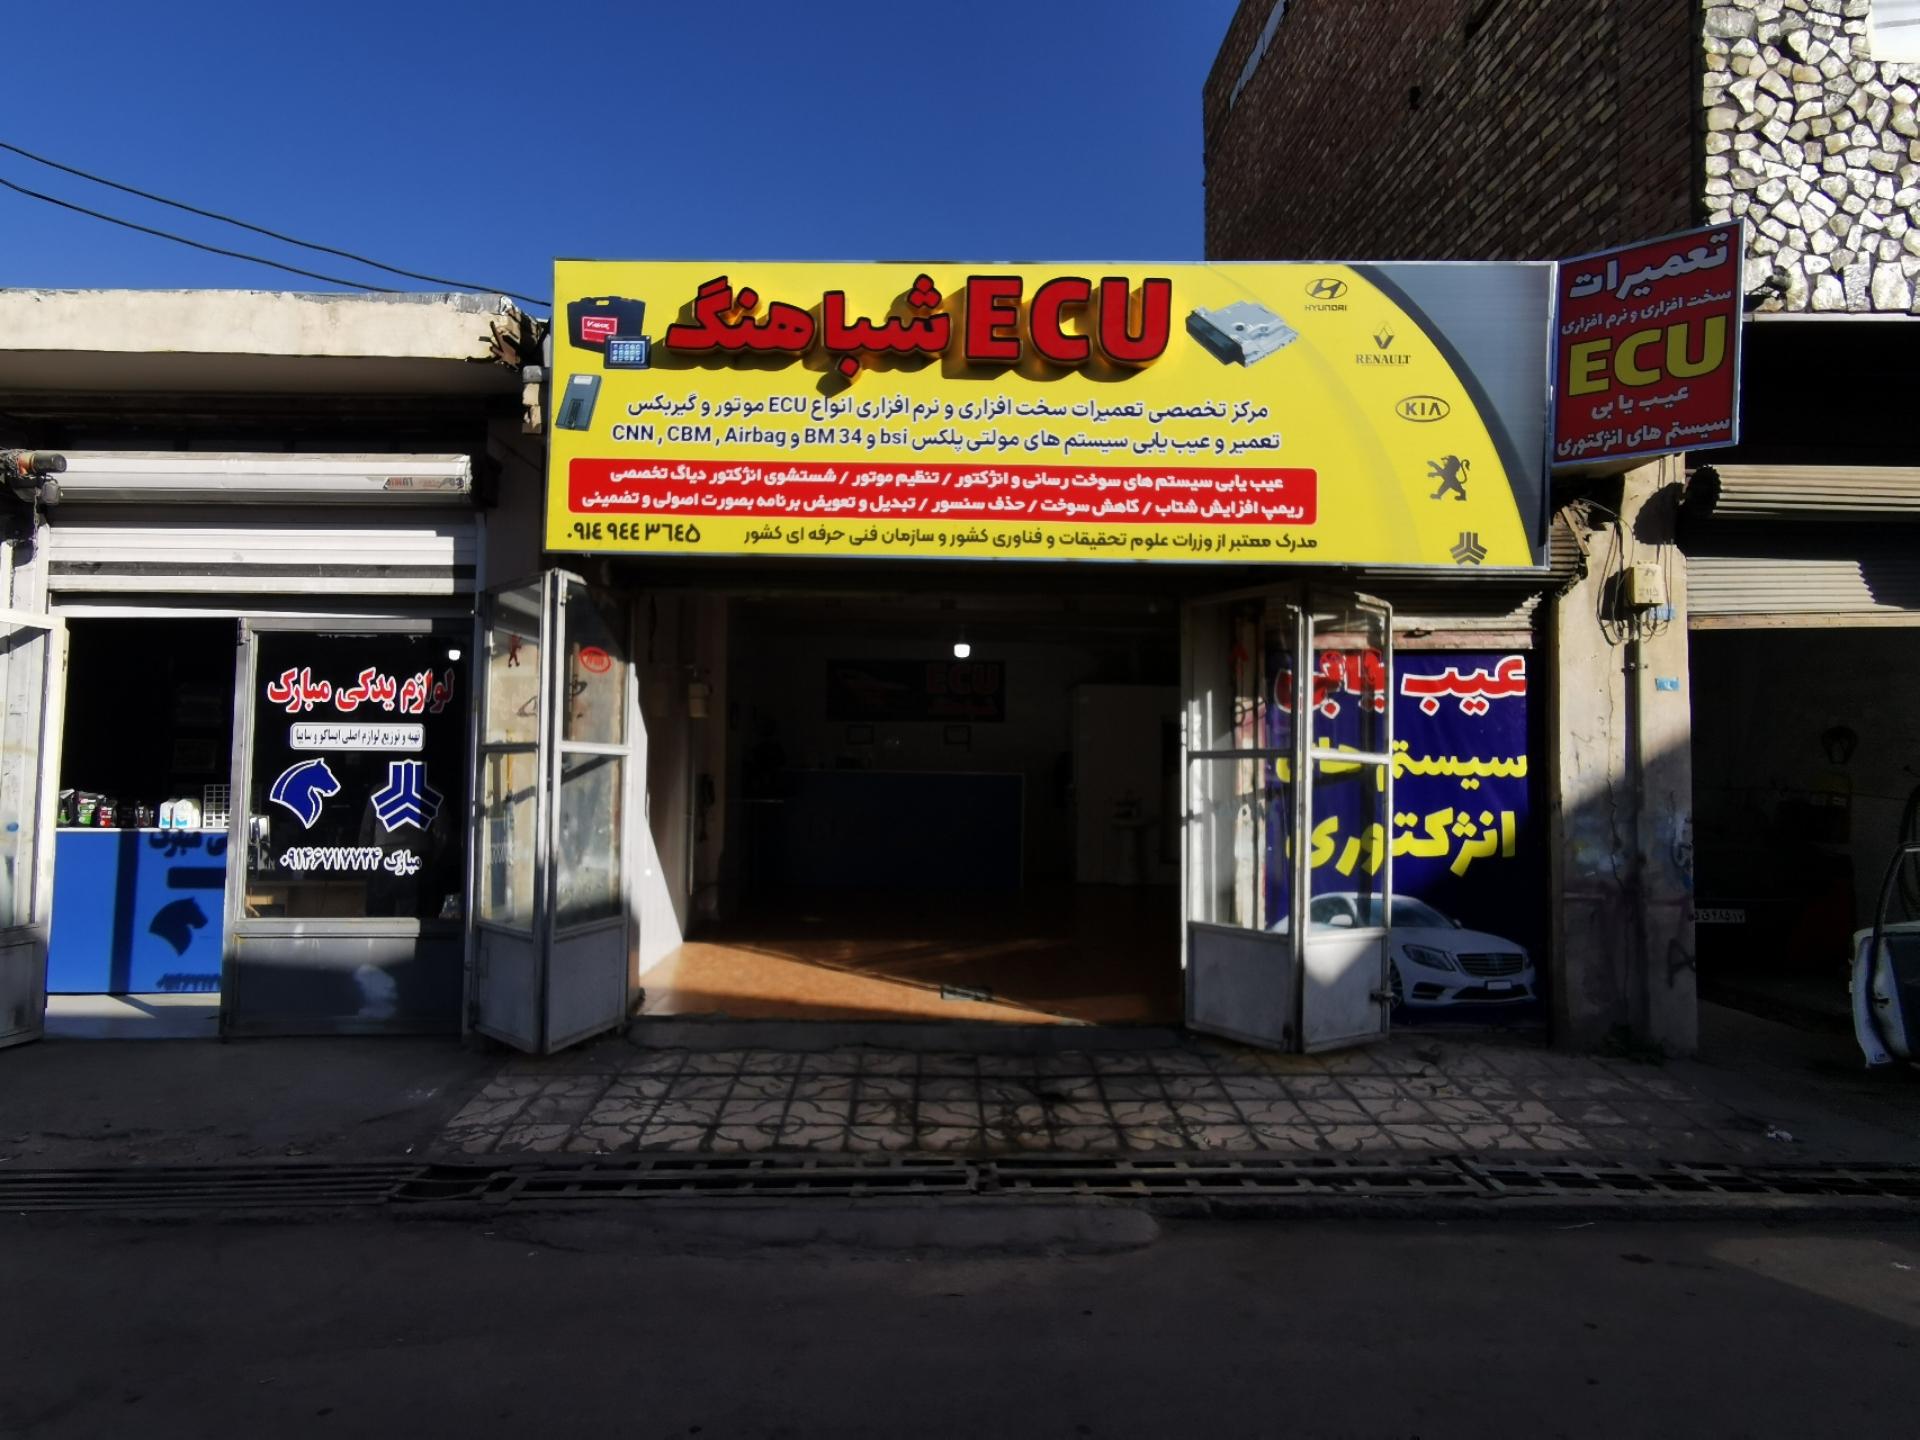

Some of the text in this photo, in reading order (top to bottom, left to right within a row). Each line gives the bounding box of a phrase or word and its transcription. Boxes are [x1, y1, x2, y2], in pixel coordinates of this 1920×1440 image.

[1569, 232, 1729, 300] تعمیرات
[1304, 304, 1347, 312] HYUNDAI
[1562, 288, 1732, 335] سخت افزاری و نرم افزاری
[665, 273, 1173, 379] ECU شباهنگ
[1356, 353, 1412, 365] RENAULT
[1568, 315, 1727, 397] ECU
[1639, 386, 1689, 411] عیب
[627, 394, 1268, 424] مرکز تخصصی تعمیرات سخت افزاری و نرم افزاری انواع ECU موتور و گیربکس
[1404, 402, 1442, 416] KIA
[612, 425, 654, 441] CNN
[667, 426, 712, 442] CBM
[725, 427, 787, 447] Airbag
[790, 435, 800, 449] و
[805, 428, 836, 444] BM
[839, 429, 862, 444] 34
[866, 434, 876, 449] و
[880, 428, 908, 444] bsi
[912, 428, 964, 452] پلکس
[966, 429, 1019, 451] مولتی
[1024, 429, 1060, 451] های
[1557, 417, 1731, 457] سیستم های انژکتوری
[1064, 433, 1128, 455] سیستم
[1132, 432, 1168, 454] یابی
[1171, 437, 1211, 454] عیب
[1215, 438, 1225, 453] و
[1229, 433, 1281, 455] تعمیر
[609, 465, 669, 483] تخصصی
[670, 464, 707, 484] دیاگ
[709, 465, 762, 485] انژکتور
[763, 467, 837, 486] شستشوی
[851, 470, 893, 487] موتور
[895, 469, 940, 487] تنظیم
[955, 469, 1009, 489] انژکتور
[1011, 475, 1021, 489] و
[1022, 472, 1069, 490] رسانی
[1071, 472, 1121, 491] سوخت
[1123, 473, 1153, 492] های
[1155, 474, 1213, 492] سیستم
[1215, 474, 1247, 492] یابی
[1249, 476, 1284, 493] عیب
[581, 490, 640, 508] تضمینی
[641, 493, 651, 509] و
[652, 491, 699, 509] اصولی
[701, 493, 754, 511] بصورت
[756, 493, 801, 512] برنامه
[802, 494, 856, 512] تعویض
[858, 497, 868, 512] و
[869, 494, 916, 513] تبدیل
[930, 497, 986, 514] سنسور
[987, 495, 1026, 513] حذف
[1040, 498, 1090, 516] سوخت
[1092, 498, 1140, 517] کاهش
[1154, 498, 1198, 517] شتاب
[1200, 498, 1259, 519] افزایش
[744, 523, 782, 545] کشور
[786, 526, 804, 544] ای
[808, 524, 846, 546] حرفه
[849, 525, 878, 546] فنی
[881, 528, 935, 547] سازمان
[938, 533, 947, 547] و
[949, 526, 989, 548] کشور
[992, 527, 1042, 548] فناوری
[1046, 536, 1055, 549] و
[1059, 530, 1127, 551] تحقیقات
[1131, 532, 1168, 551] علوم
[1215, 533, 1226, 552] از
[1228, 534, 1271, 552] معتبر
[1275, 534, 1318, 553] مدرک
[267, 666, 455, 713] لوازم یدکی مبارک
[1400, 655, 1528, 717] عیب
[362, 729, 381, 745] لوازم
[384, 849, 422, 876] مبارک
